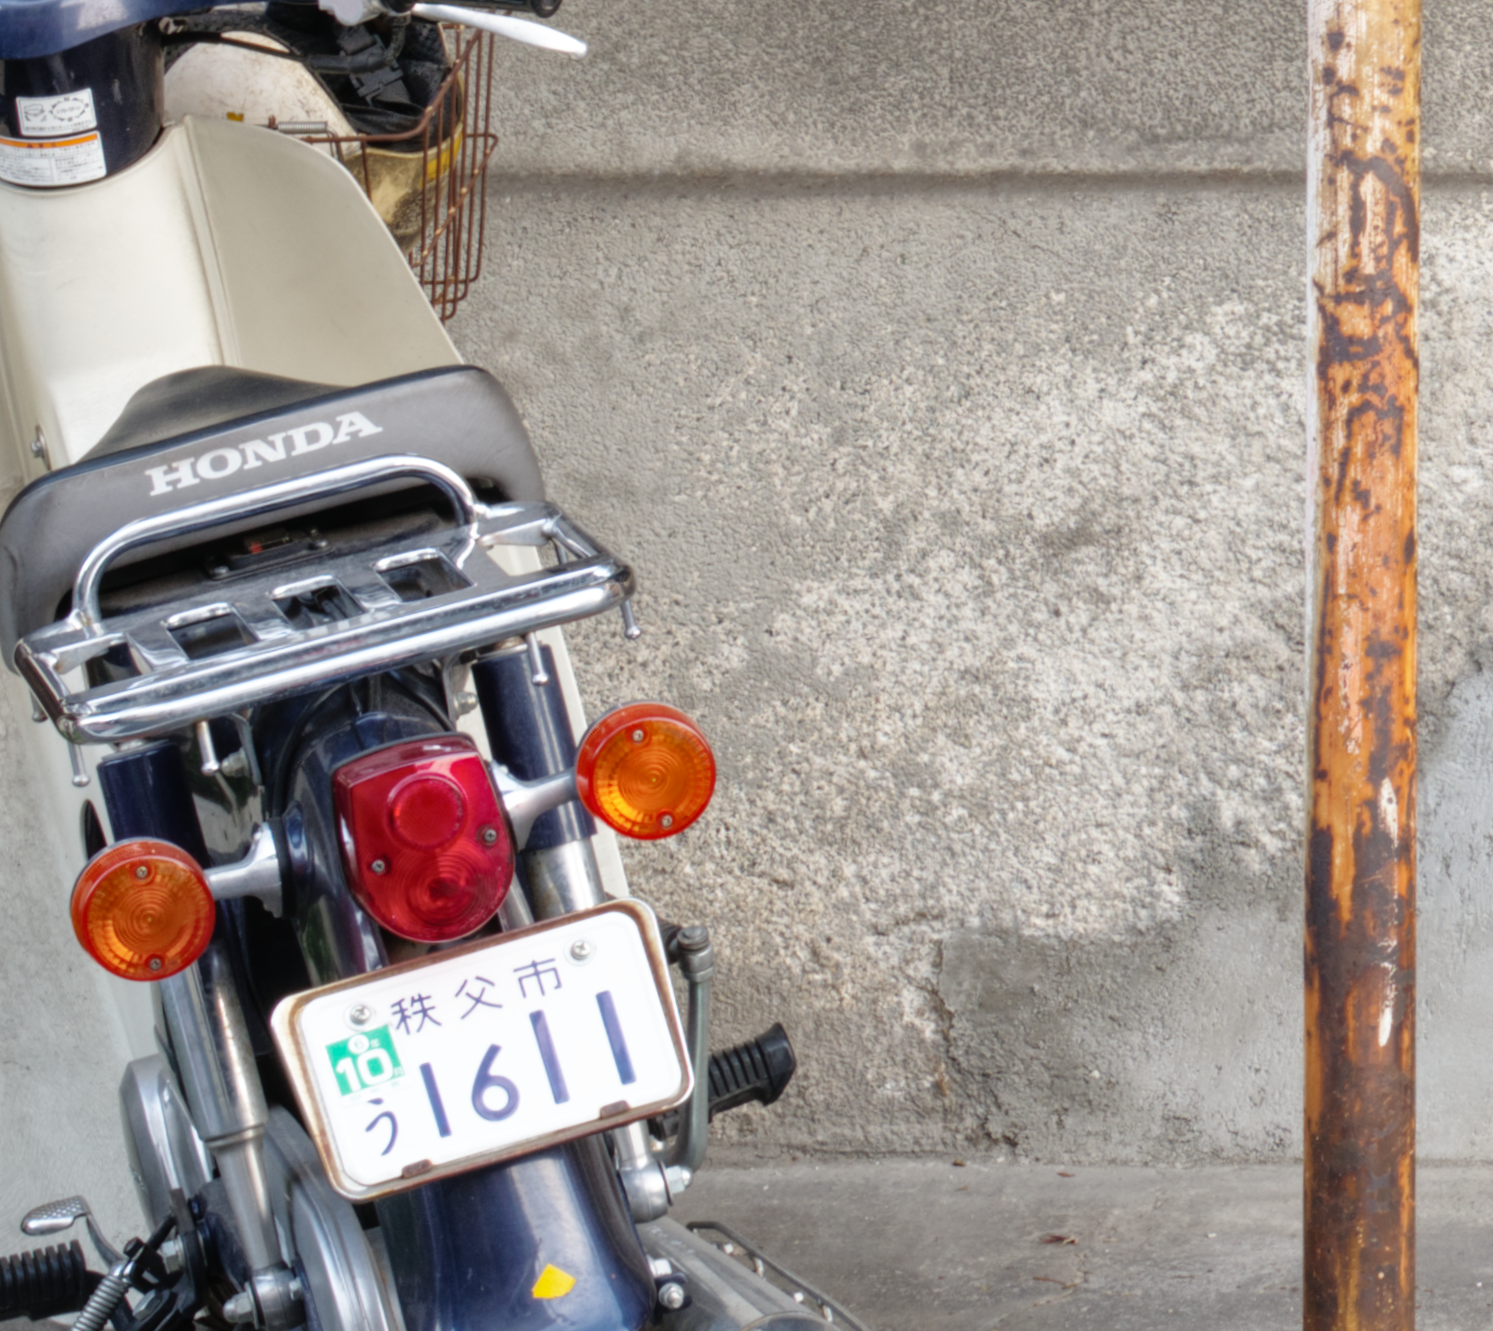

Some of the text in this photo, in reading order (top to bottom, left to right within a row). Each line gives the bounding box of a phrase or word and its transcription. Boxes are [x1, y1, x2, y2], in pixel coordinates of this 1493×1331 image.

[146, 410, 383, 498] HONDA
[390, 957, 563, 1036] 秩父市
[365, 990, 637, 1157] う 1611
